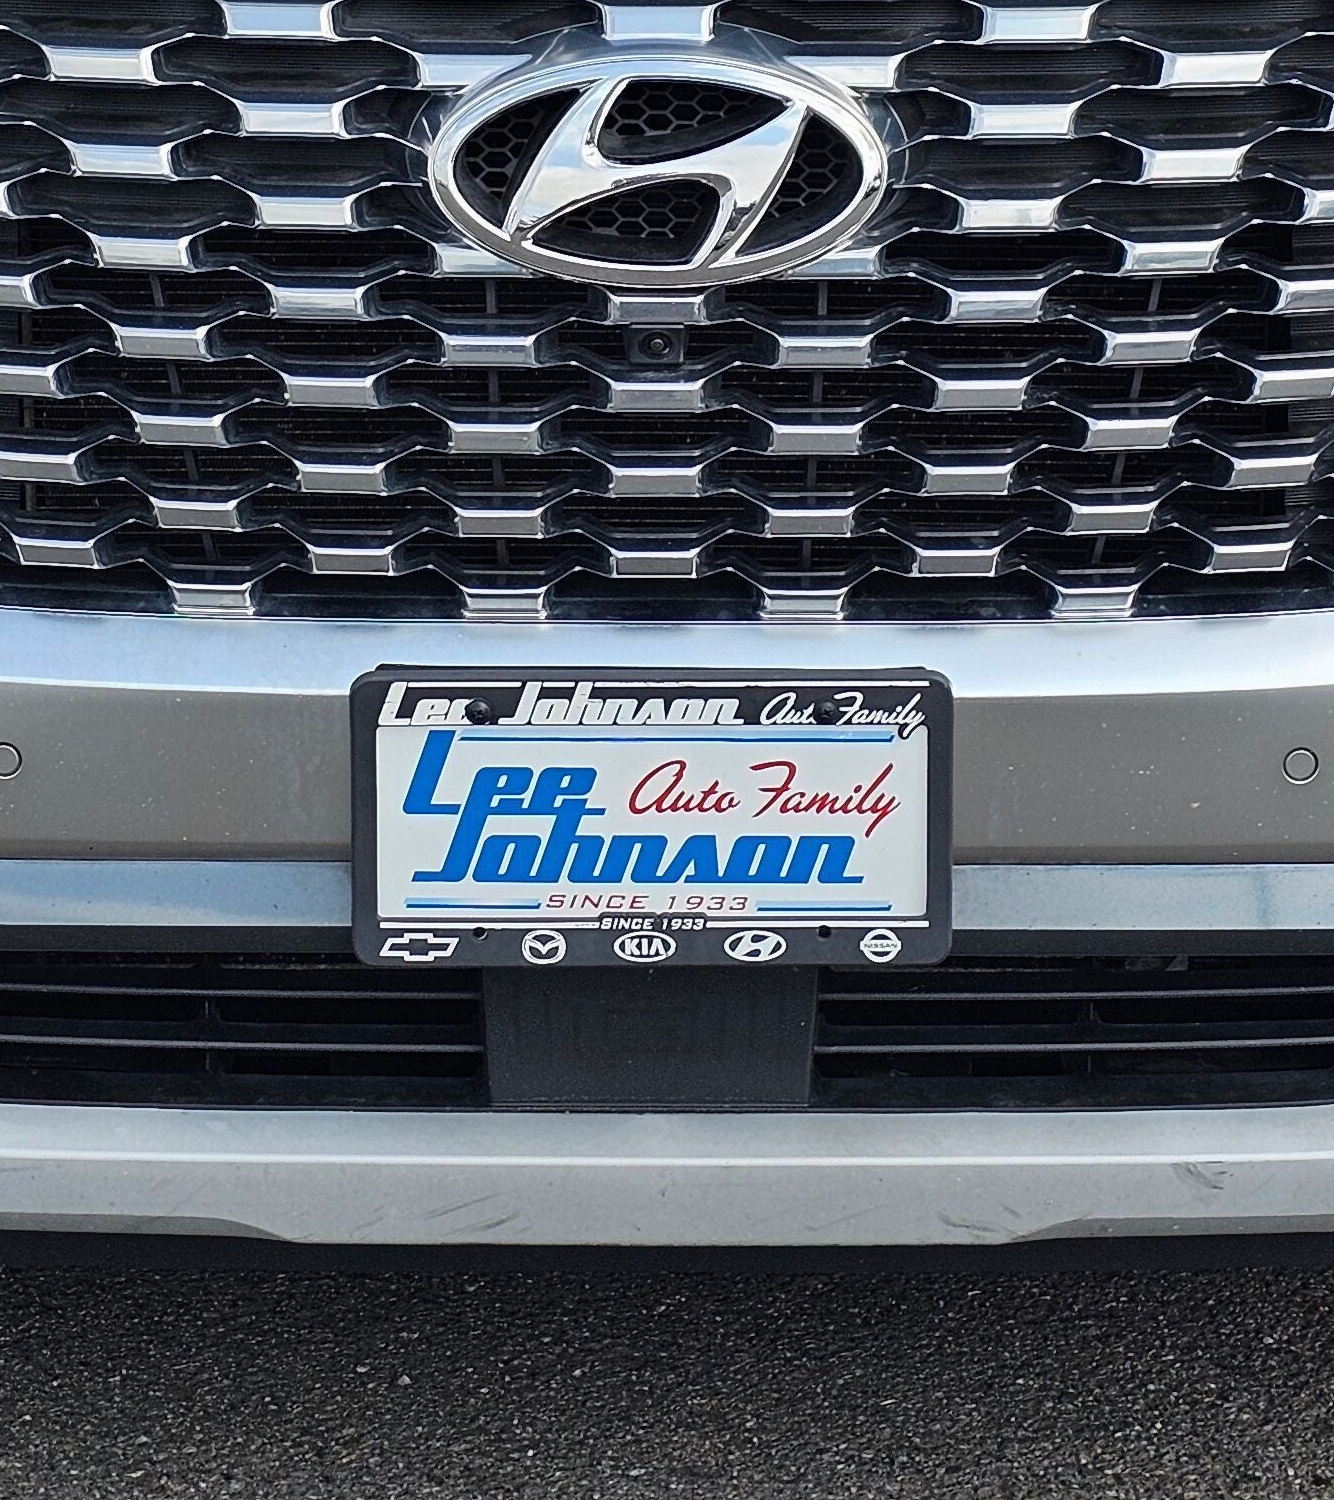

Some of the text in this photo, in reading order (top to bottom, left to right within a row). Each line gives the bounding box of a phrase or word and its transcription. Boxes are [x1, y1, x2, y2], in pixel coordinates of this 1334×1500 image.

[498, 681, 745, 726] Johnson
[759, 691, 829, 725] Aut
[833, 691, 926, 738] Family
[402, 729, 902, 838] Lee Auto Family
[410, 812, 865, 885] Johnson
[546, 894, 749, 911] SINCE 1933
[600, 917, 706, 931] SINCE 1933
[623, 937, 667, 956] KIA
